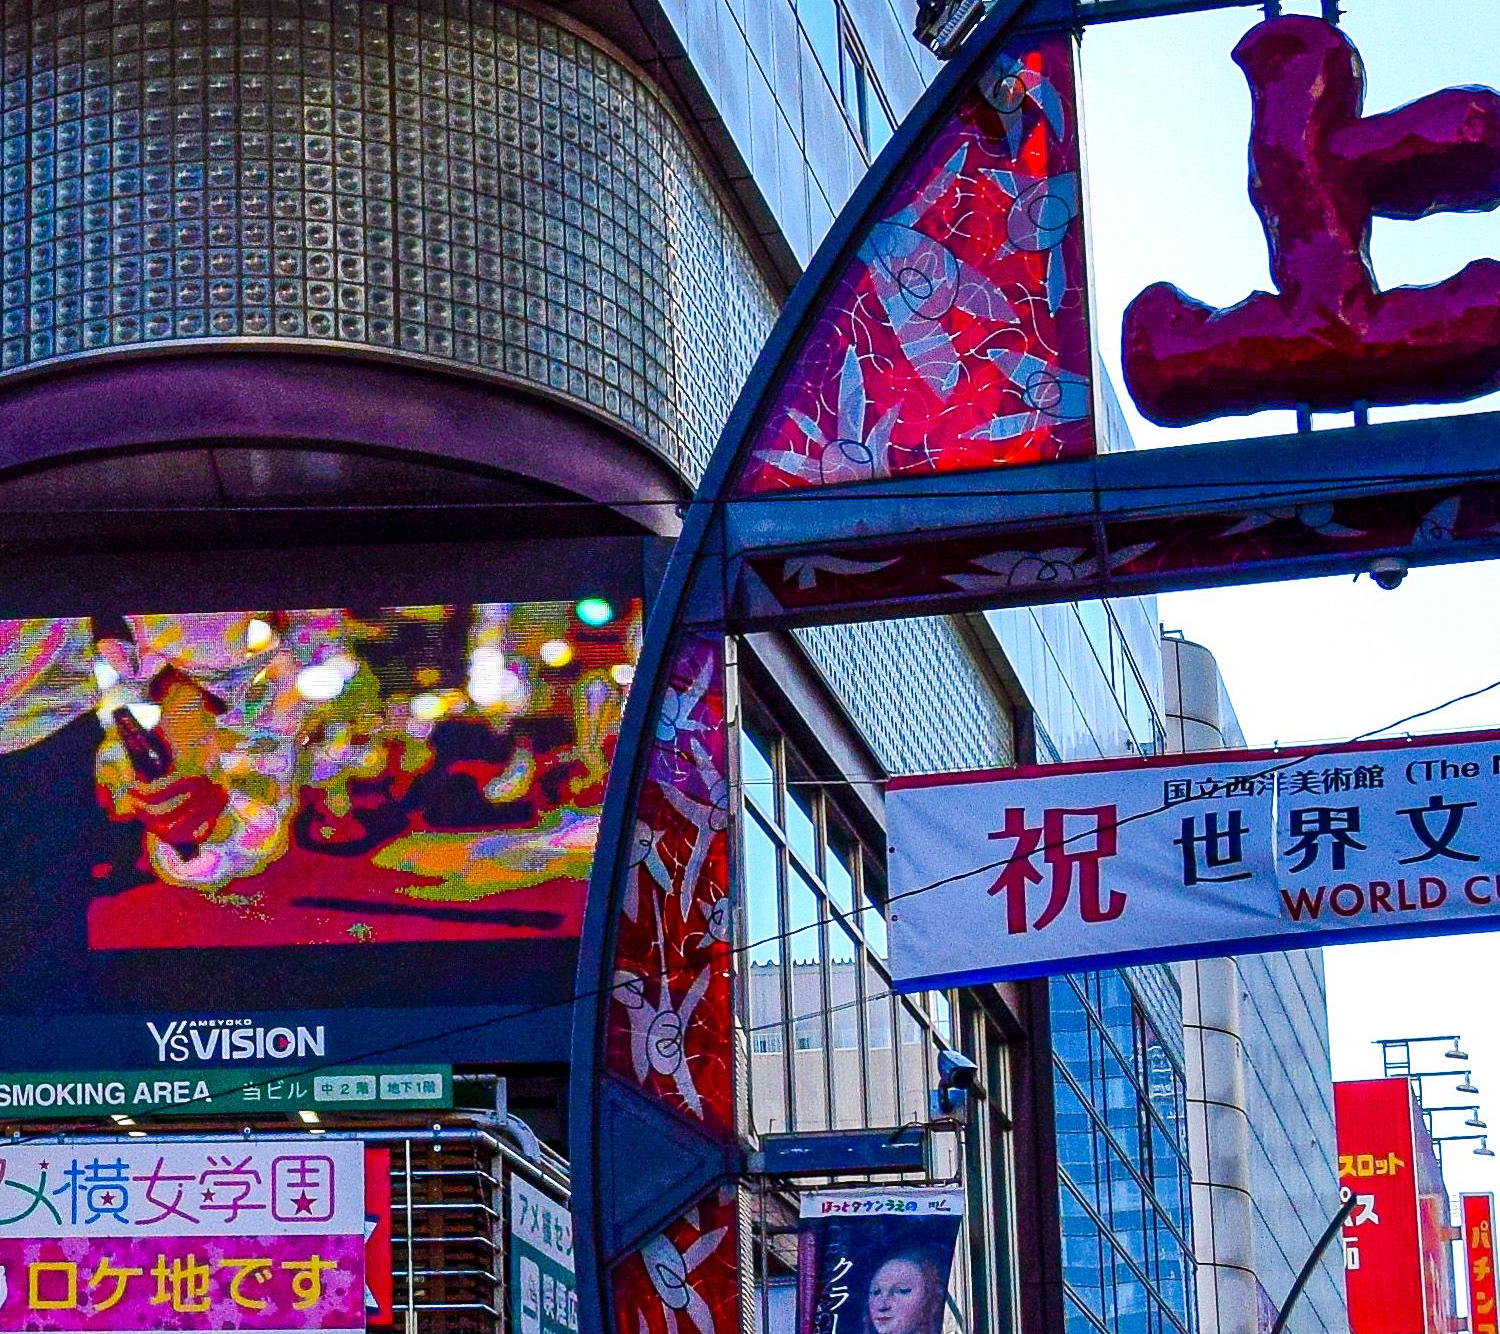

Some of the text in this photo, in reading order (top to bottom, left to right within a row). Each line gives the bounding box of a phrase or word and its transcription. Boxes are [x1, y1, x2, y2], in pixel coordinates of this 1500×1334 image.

[1162, 761, 1385, 809] 国立西洋美術館
[1405, 749, 1480, 786] (The
[986, 803, 1128, 936] 祝
[1279, 875, 1449, 922] WORLD
[132, 1080, 213, 1105] AREA
[242, 1080, 308, 1101] 当ビル
[1338, 1152, 1406, 1178] スロット
[820, 1199, 919, 1214] ほっとタウンうえの
[27, 1252, 340, 1313] ロケ地です
